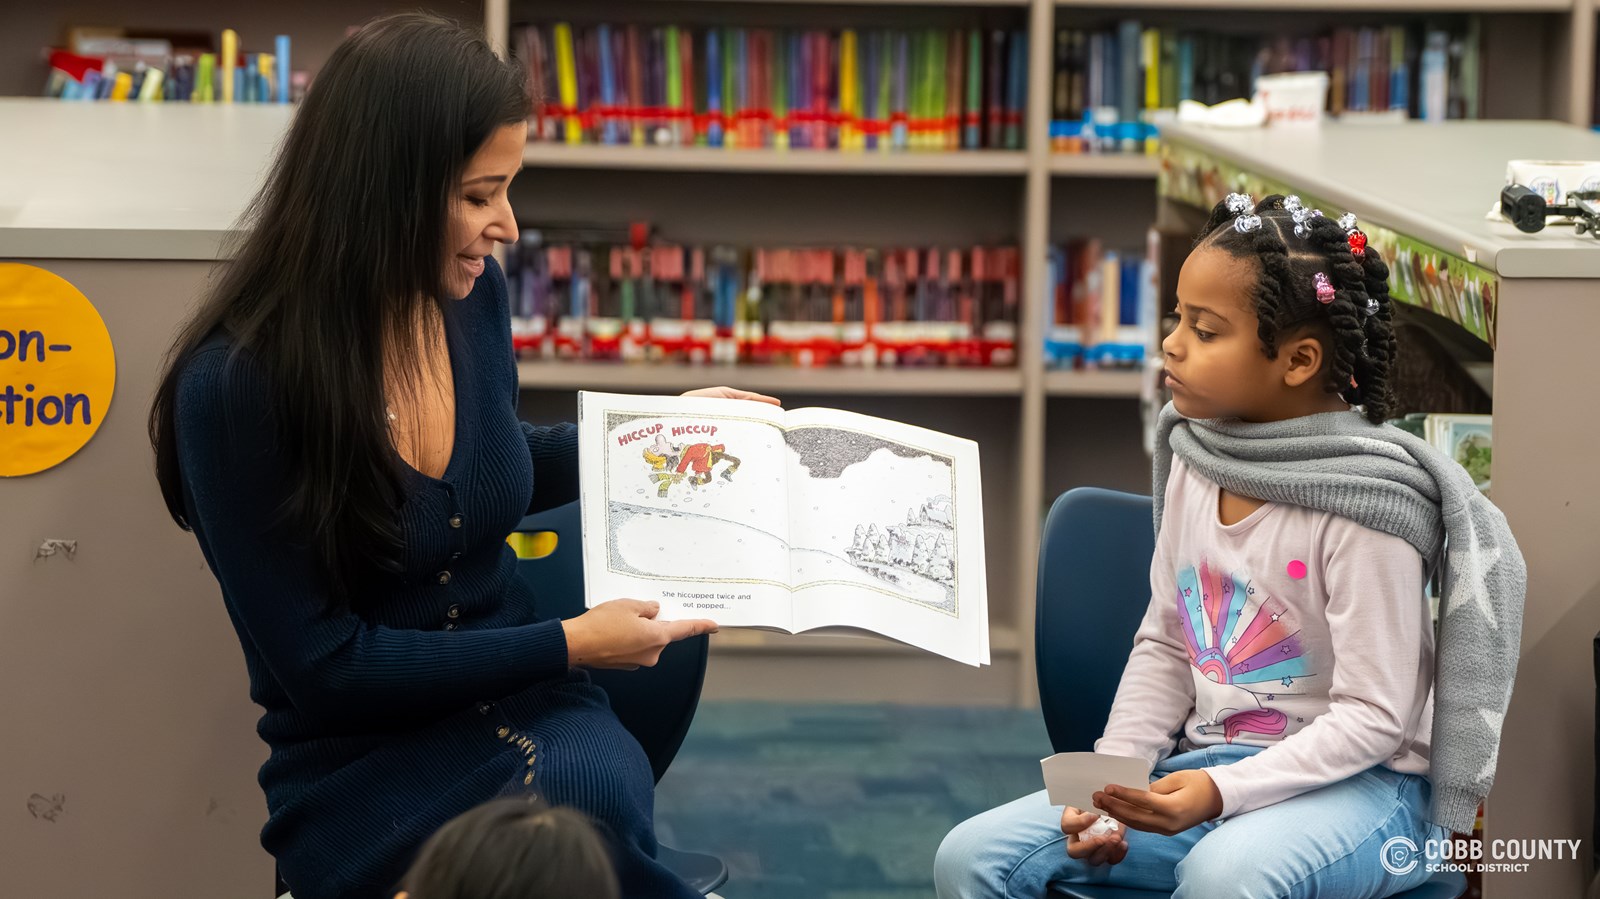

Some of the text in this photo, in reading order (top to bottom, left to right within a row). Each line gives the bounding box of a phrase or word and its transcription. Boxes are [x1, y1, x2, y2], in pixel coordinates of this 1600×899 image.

[0, 384, 92, 427] tion
[617, 423, 664, 446] HICCUP
[677, 592, 714, 600] hiccupped
